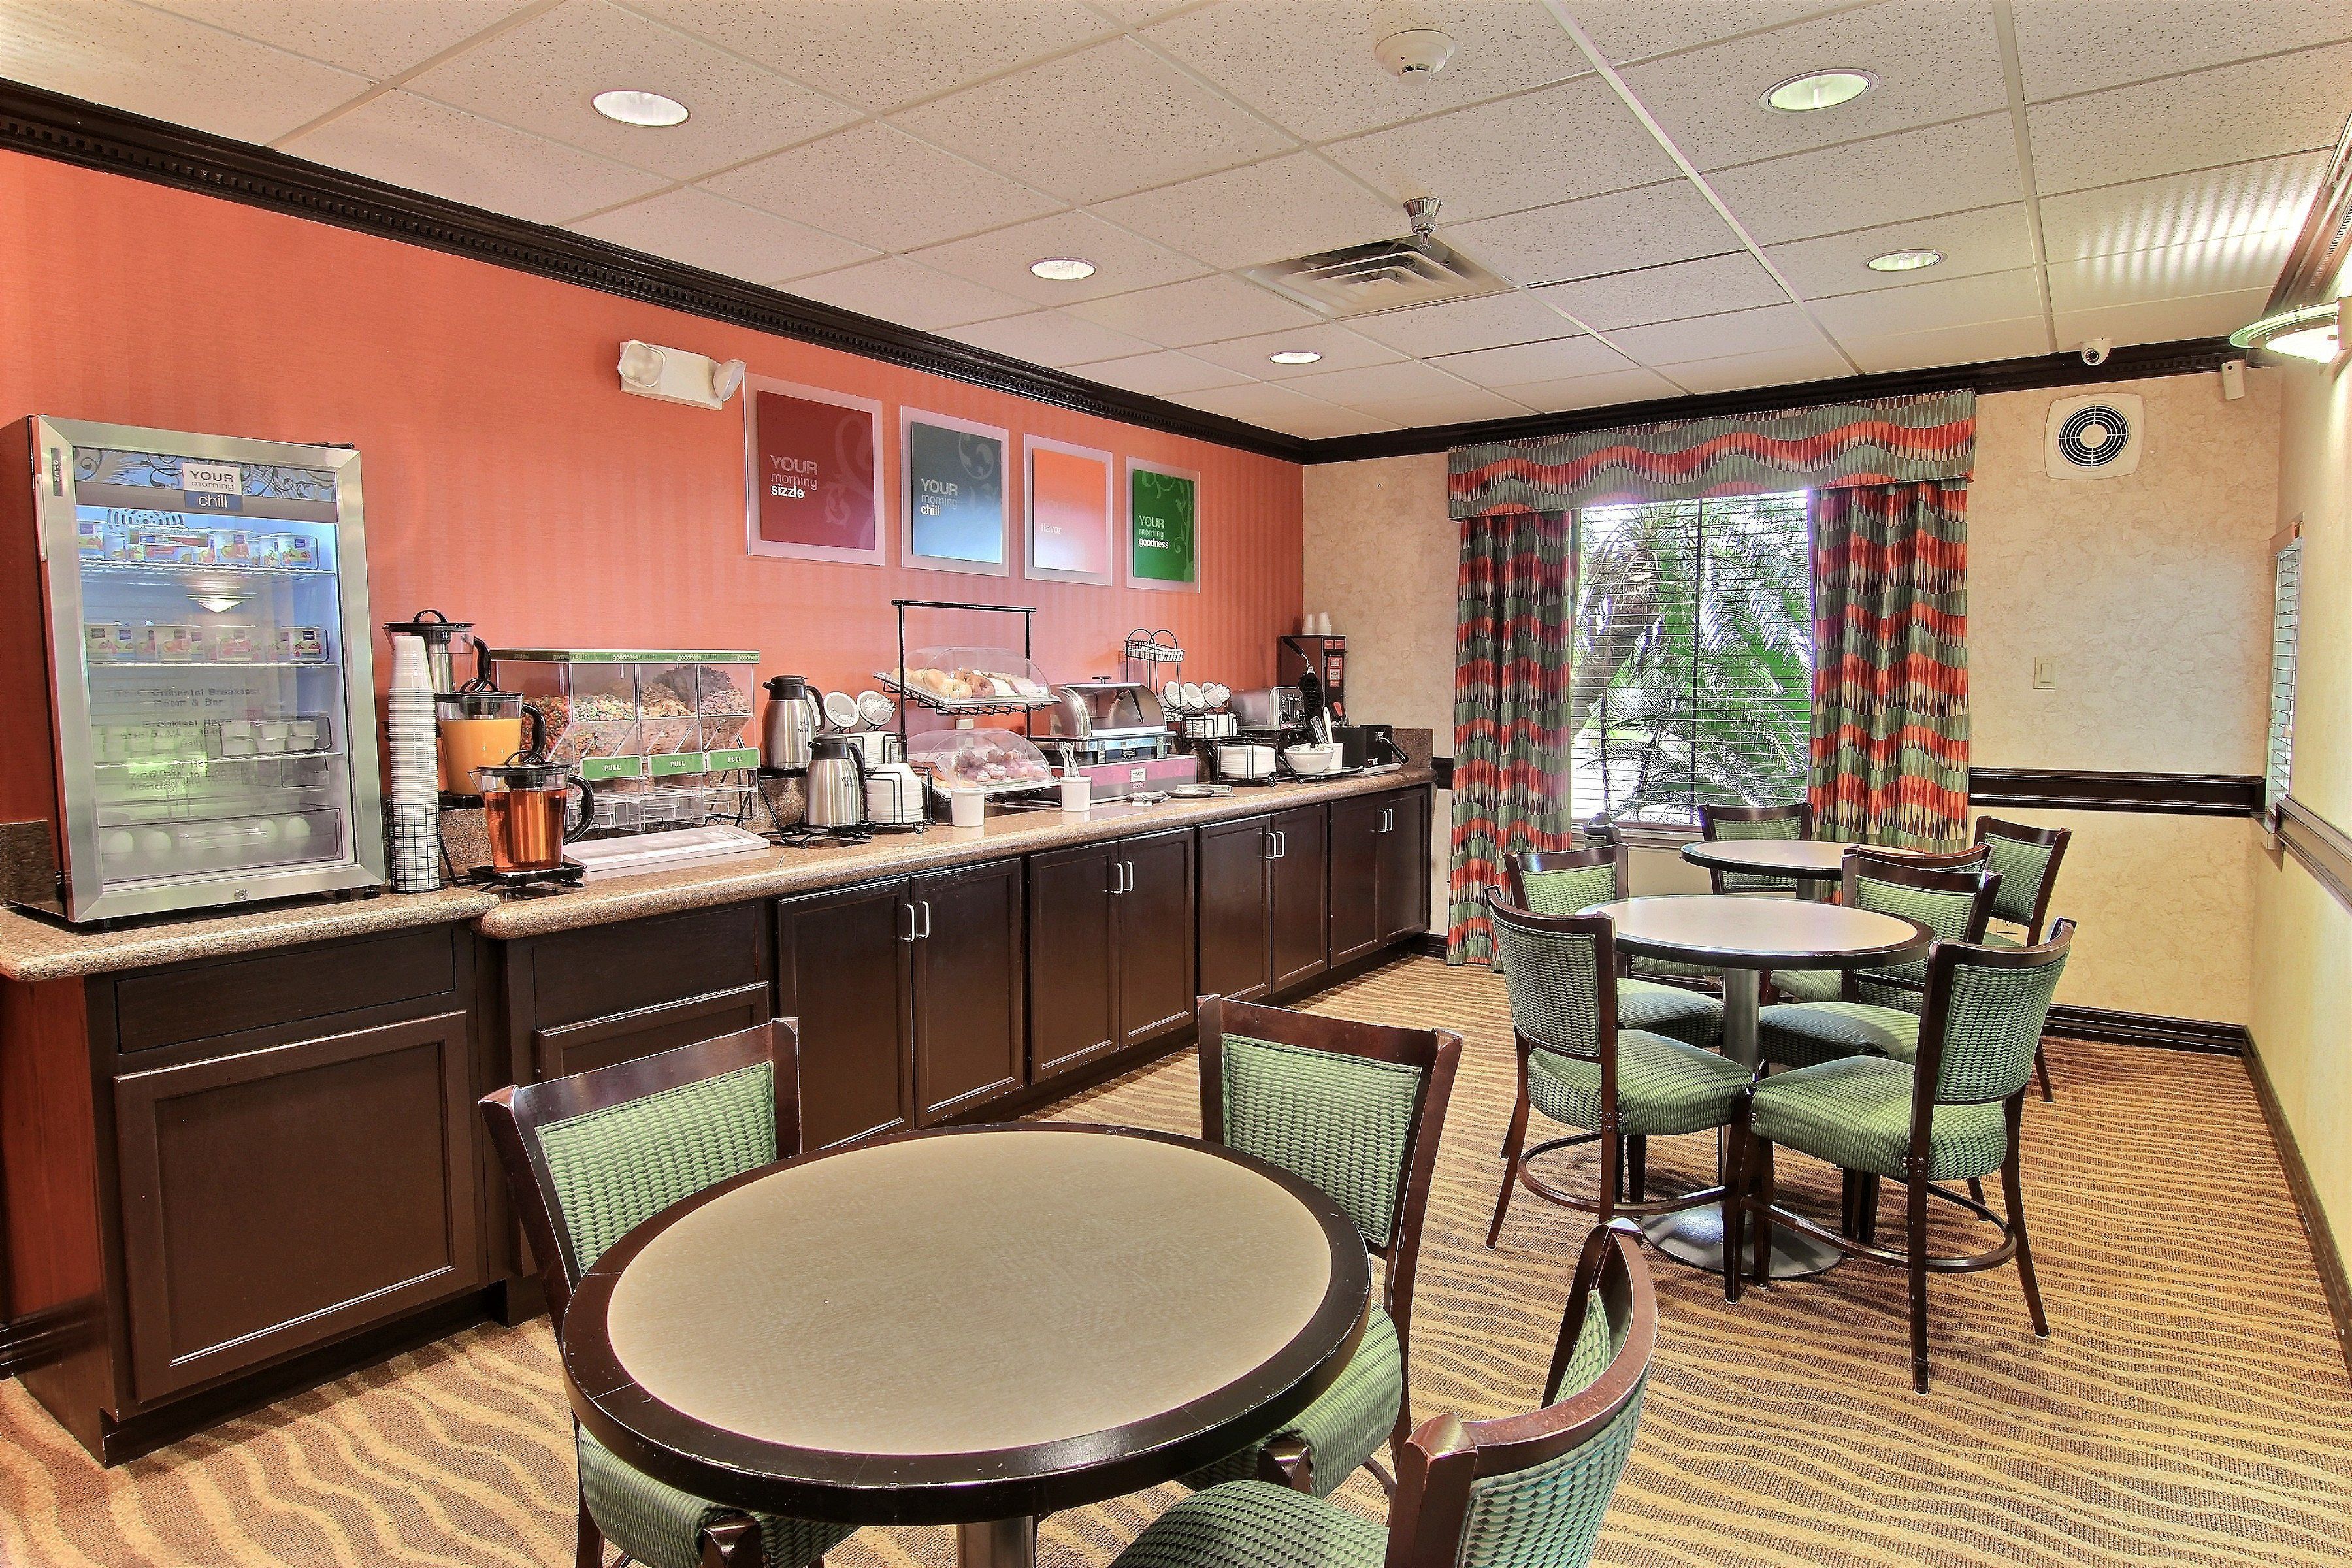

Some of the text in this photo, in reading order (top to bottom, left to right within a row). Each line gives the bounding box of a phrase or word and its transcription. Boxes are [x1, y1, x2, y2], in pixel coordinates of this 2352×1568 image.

[770, 455, 818, 475] YOUR
[190, 470, 234, 482] YOUR
[771, 473, 817, 490] morning
[191, 481, 234, 491] morning
[771, 483, 805, 498] sizzle
[921, 478, 958, 495] YOUR
[198, 494, 227, 508] chill
[921, 494, 958, 510] morning
[921, 504, 941, 516] chill
[1040, 522, 1062, 534] flavor
[1139, 515, 1164, 529] YOUR
[1139, 528, 1164, 540] morning
[1139, 537, 1169, 549] goodness
